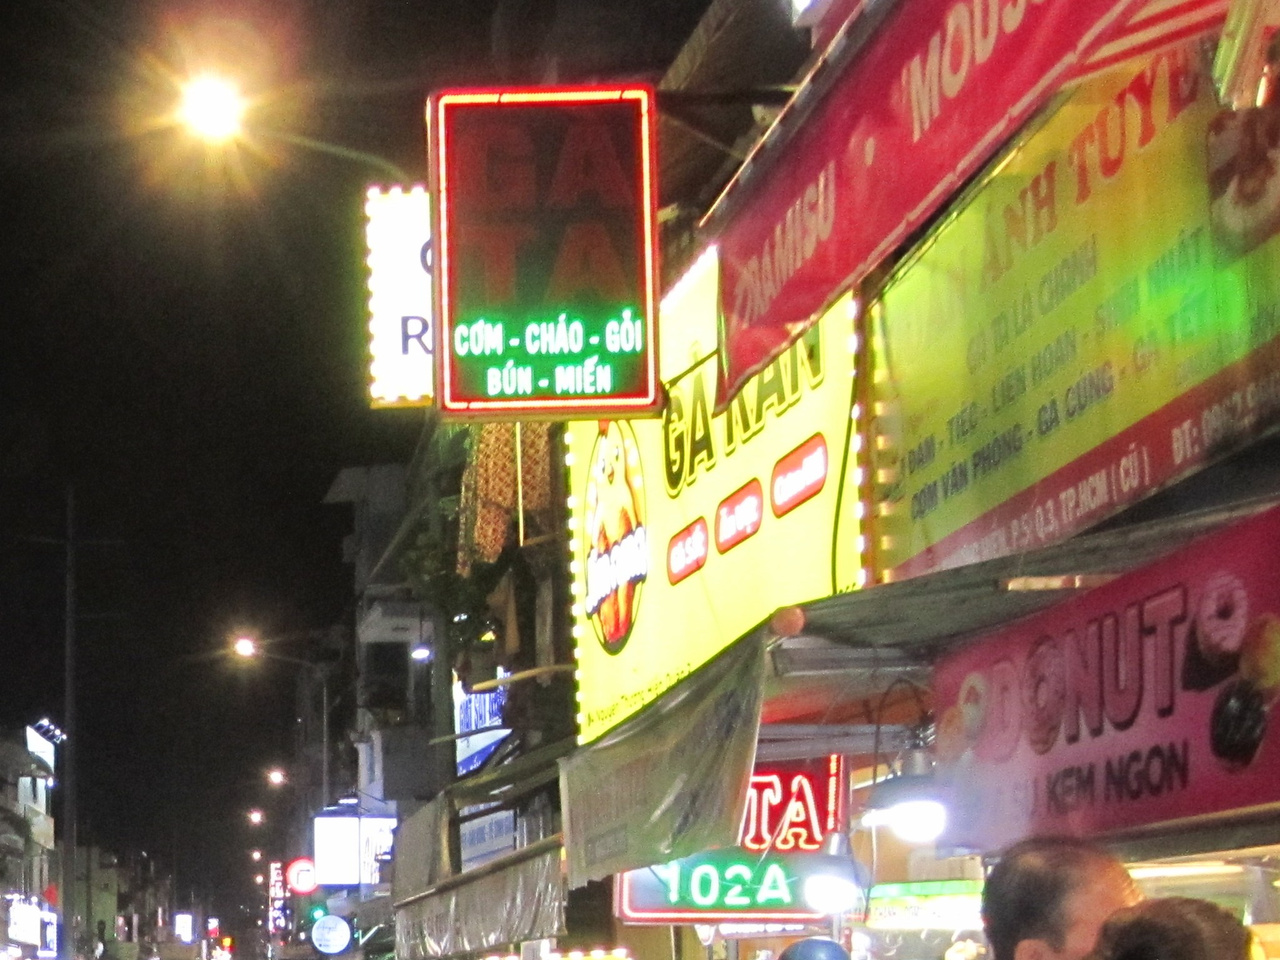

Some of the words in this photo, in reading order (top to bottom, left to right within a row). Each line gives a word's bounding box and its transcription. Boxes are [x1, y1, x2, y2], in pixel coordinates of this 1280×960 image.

[455, 319, 504, 356] CƠM
[524, 313, 584, 355] CHÁO
[604, 309, 643, 353] GỎI
[487, 358, 532, 397] BÚN
[554, 355, 612, 394] MIẾN
[1103, 740, 1188, 803] NGON
[744, 775, 824, 850] TA
[668, 862, 792, 906] 102A
